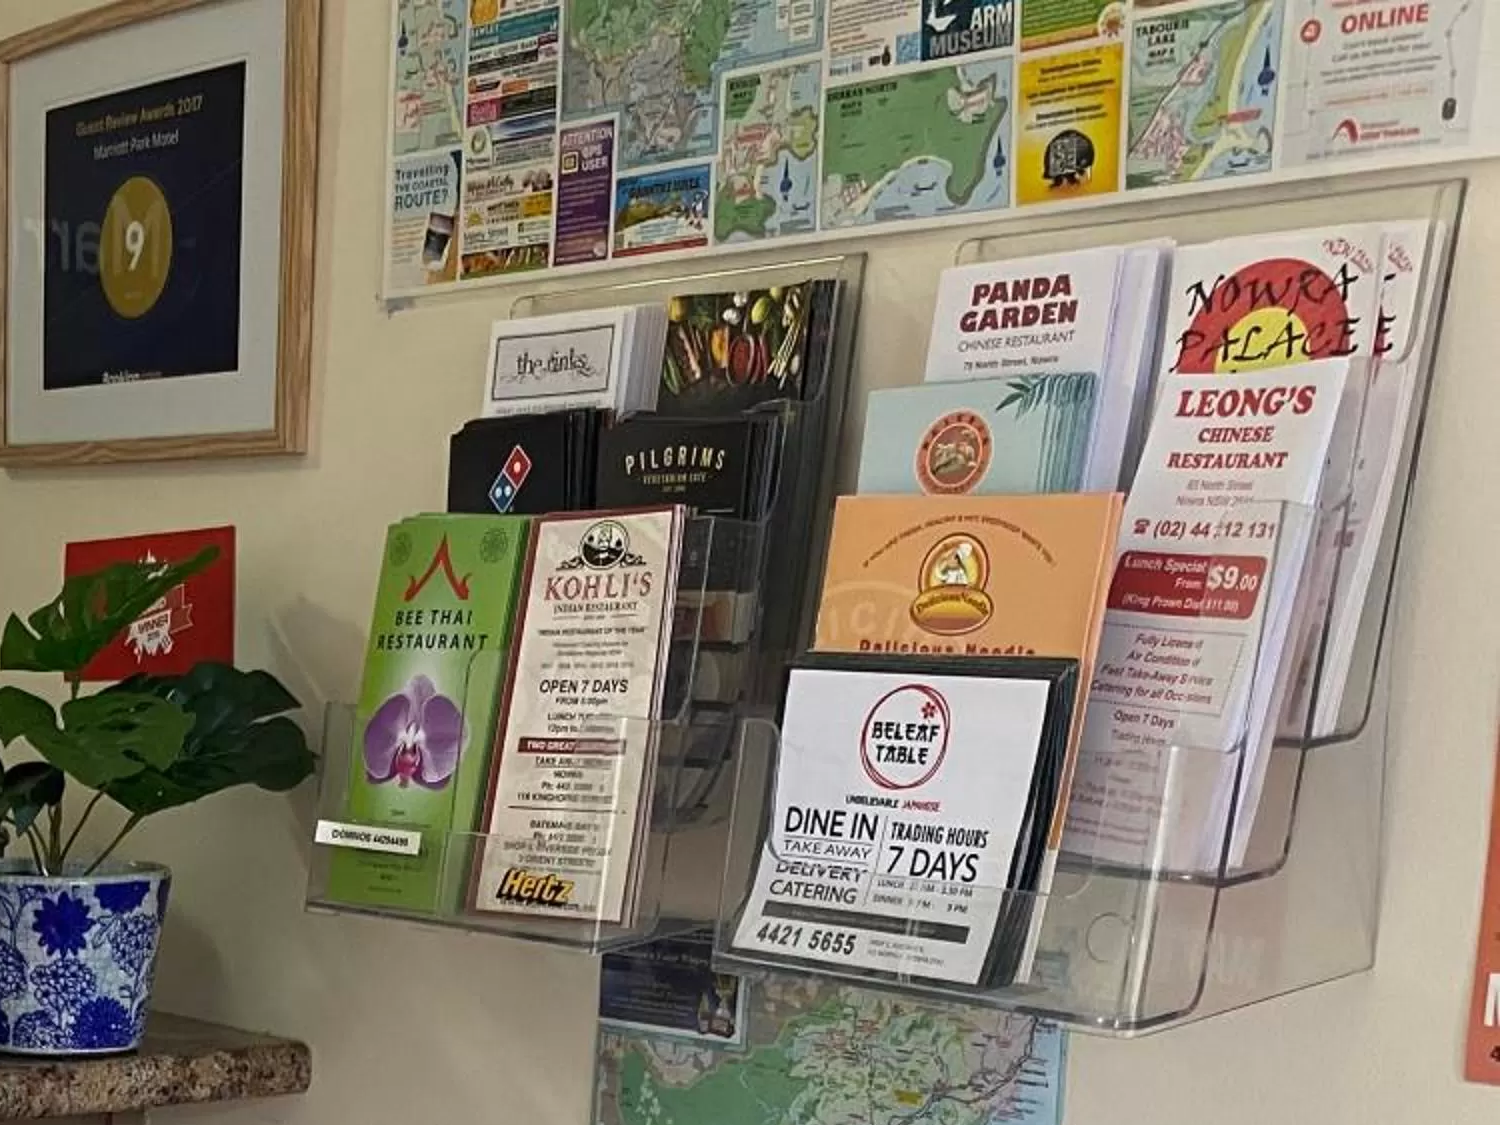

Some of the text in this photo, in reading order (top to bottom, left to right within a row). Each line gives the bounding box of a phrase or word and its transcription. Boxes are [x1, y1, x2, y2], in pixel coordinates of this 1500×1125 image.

[970, 3, 1013, 30] ARM
[1341, 3, 1429, 34] ONLINE
[929, 26, 1013, 57] MUSEUM
[561, 126, 614, 147] ATTENTION
[395, 163, 449, 181] Travelling
[581, 157, 609, 171] USER
[394, 190, 449, 211] ROUTE?
[124, 220, 145, 271] 9
[971, 273, 1072, 306] PANDA
[1186, 262, 1359, 316] NOWRA
[959, 299, 1078, 333] GARDEN
[958, 330, 1076, 352] CHINESE RESTAURANT
[1168, 316, 1361, 373] PALACE
[1175, 385, 1317, 418] LEONG'S
[1197, 426, 1275, 444] CHINESE
[625, 446, 725, 475] PILGRIMS
[1166, 451, 1289, 469] RESTAURANT
[1152, 520, 1186, 540] (02)
[1124, 556, 1208, 574] Lunch Special
[544, 571, 653, 601] KOHLI'S
[394, 608, 473, 627] BEE THAI
[553, 601, 639, 614] INDIAN RESTAURANT
[376, 633, 489, 652] RESTAURANT
[1135, 632, 1160, 648] Fully
[1126, 651, 1142, 663] Air
[539, 679, 579, 694] OPEN
[591, 679, 629, 694] DAYS
[1134, 684, 1150, 697] for
[1150, 687, 1165, 699] all
[1113, 709, 1141, 725] Open
[1150, 715, 1176, 730] Days
[871, 721, 940, 742] BELEAF
[546, 741, 577, 752] GREAT
[875, 745, 929, 765] TABLE
[784, 806, 879, 841] DINE IN
[890, 821, 990, 849] TRADING HOURS
[783, 839, 873, 860] TAKE AWAY
[775, 861, 868, 884] DELIVERY
[886, 846, 980, 884] 7 DAYS
[498, 868, 575, 905] Hertz
[768, 879, 859, 905] CATERING
[876, 878, 906, 889] LUNCH
[756, 921, 803, 946] 4421
[807, 929, 857, 955] 5655
